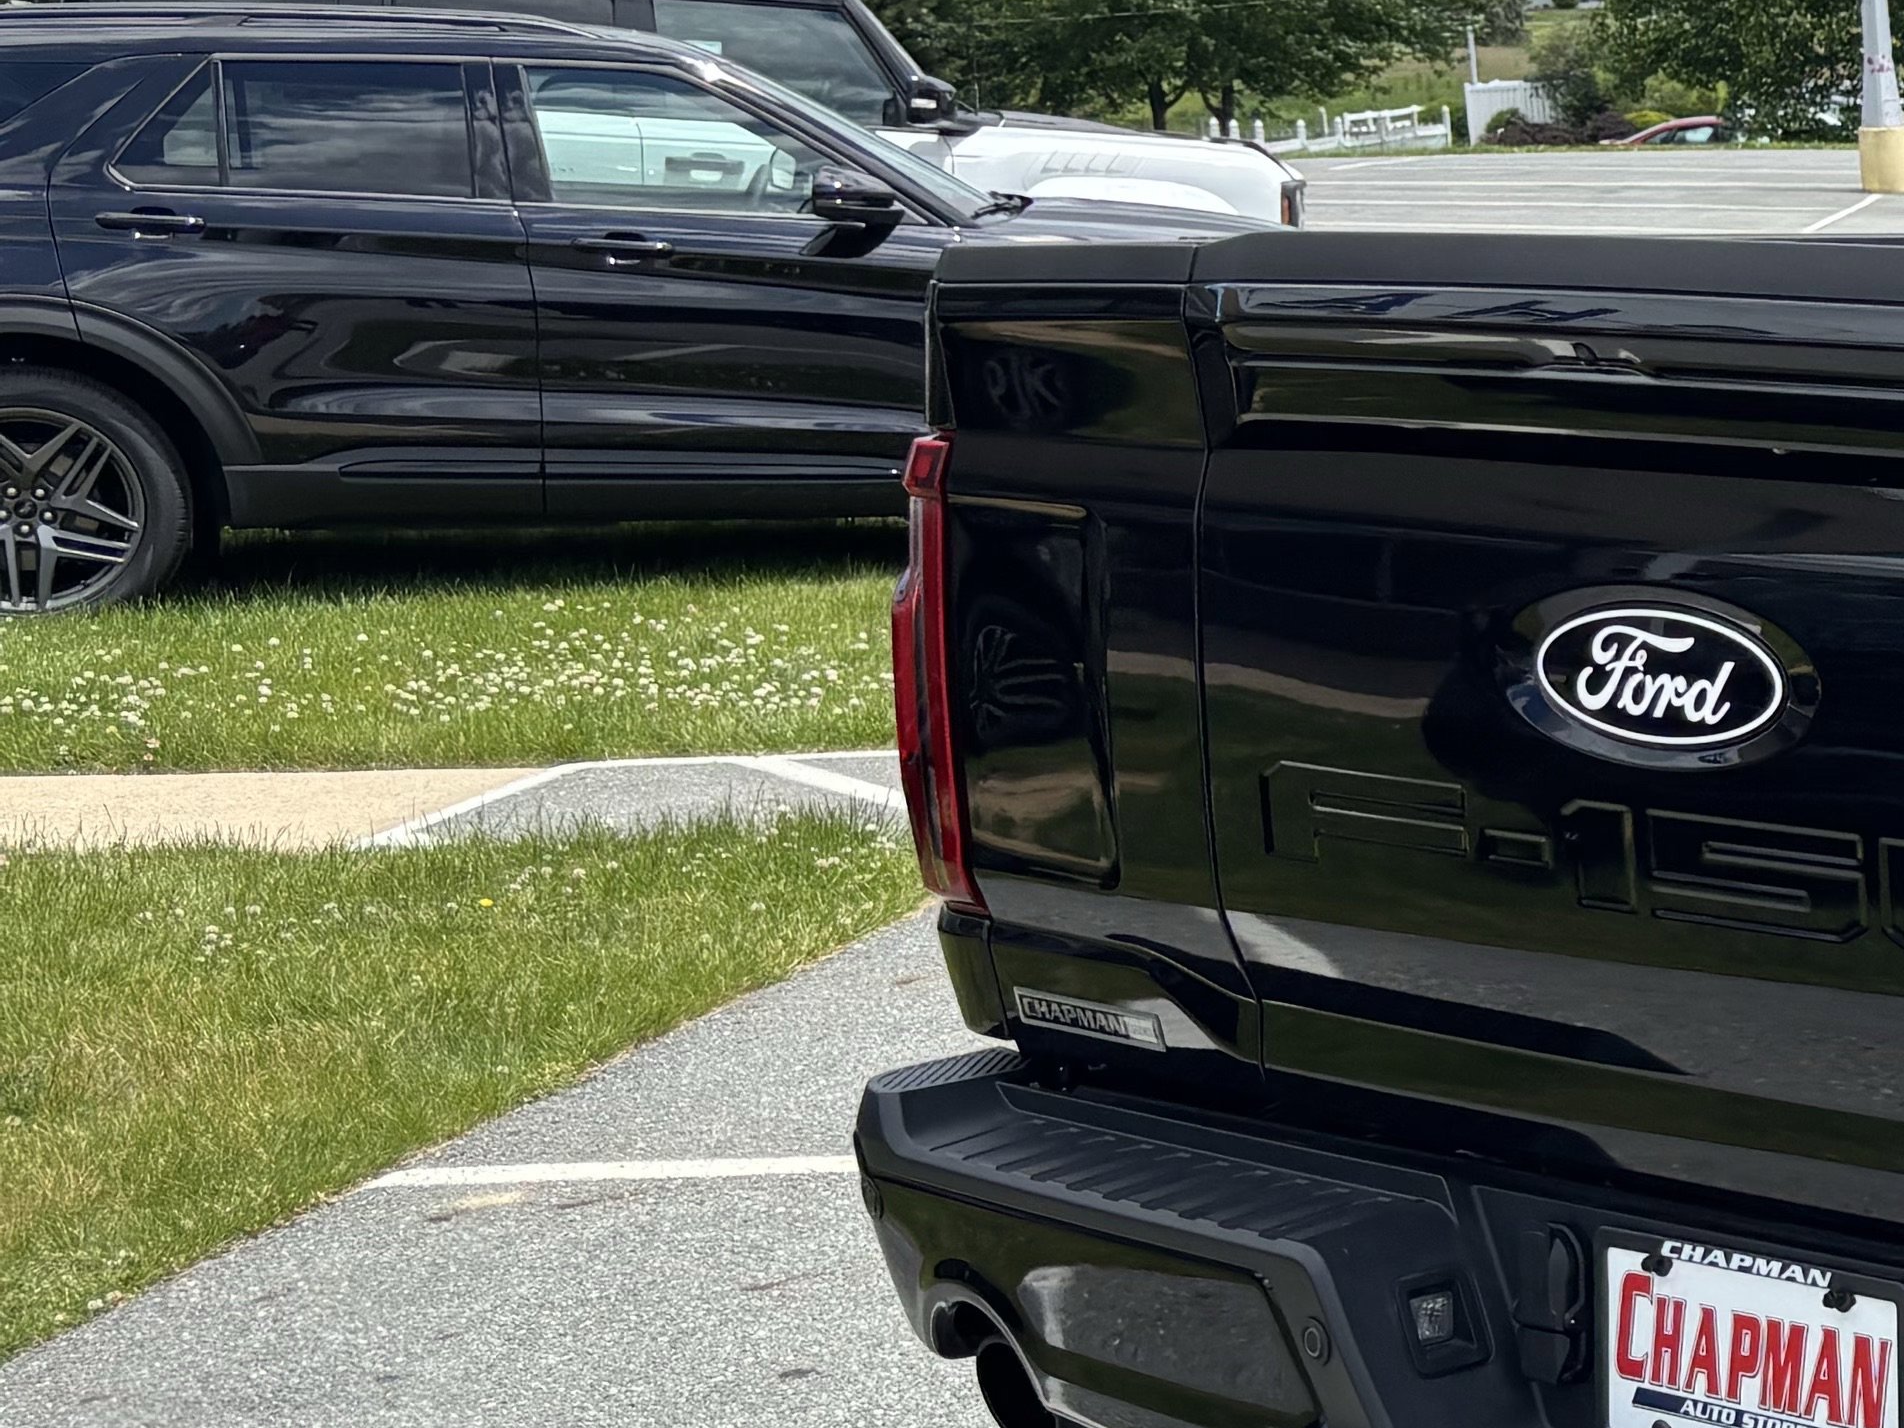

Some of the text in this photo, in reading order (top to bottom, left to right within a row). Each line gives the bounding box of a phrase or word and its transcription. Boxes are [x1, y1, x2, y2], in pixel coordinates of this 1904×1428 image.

[1576, 624, 1735, 725] Ford
[1022, 996, 1129, 1038] CHAPMAN
[1661, 1240, 1832, 1289] CHAPMAN
[1680, 1399, 1736, 1426] AUTO
